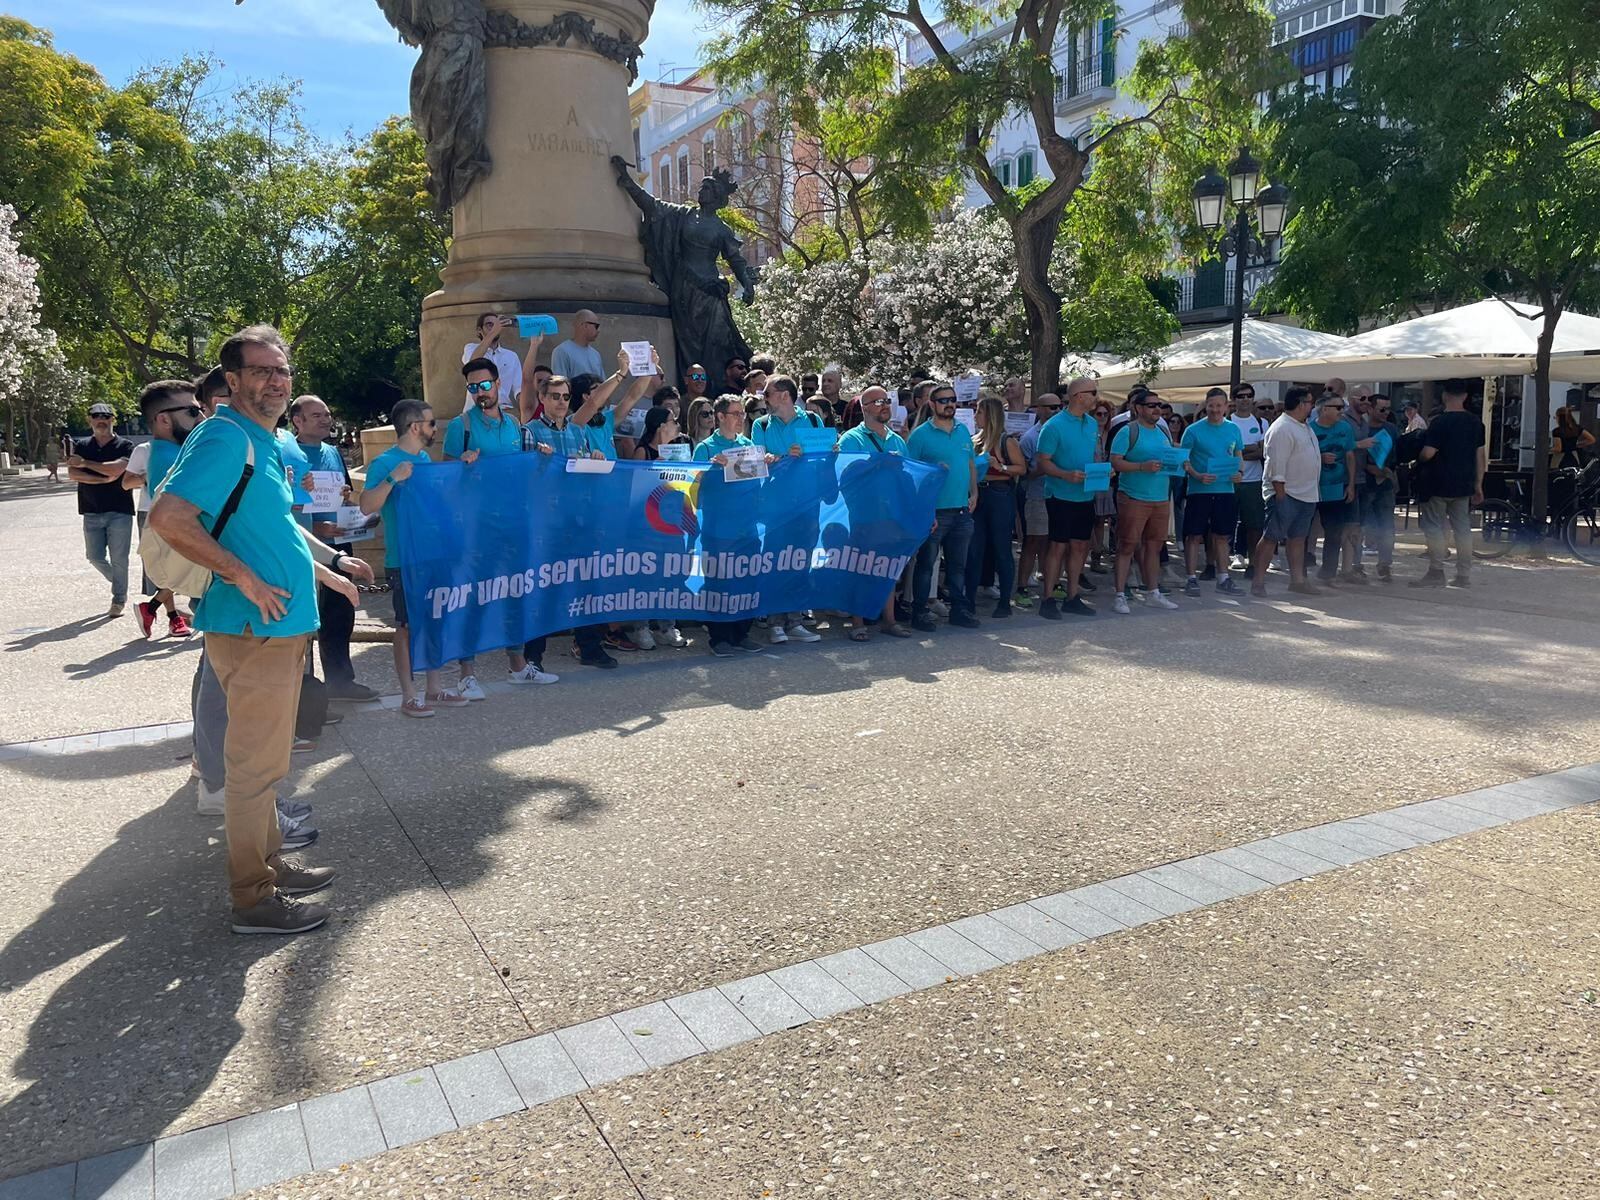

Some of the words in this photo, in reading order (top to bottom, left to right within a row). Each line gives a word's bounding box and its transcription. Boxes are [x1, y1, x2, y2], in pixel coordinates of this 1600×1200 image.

[566, 105, 579, 127] A
[659, 471, 687, 482] digna
[477, 568, 535, 606] unos
[538, 548, 657, 588] servicios
[663, 549, 774, 579] públicos
[777, 545, 807, 571] de
[568, 588, 760, 618] #InsularidadDigna
